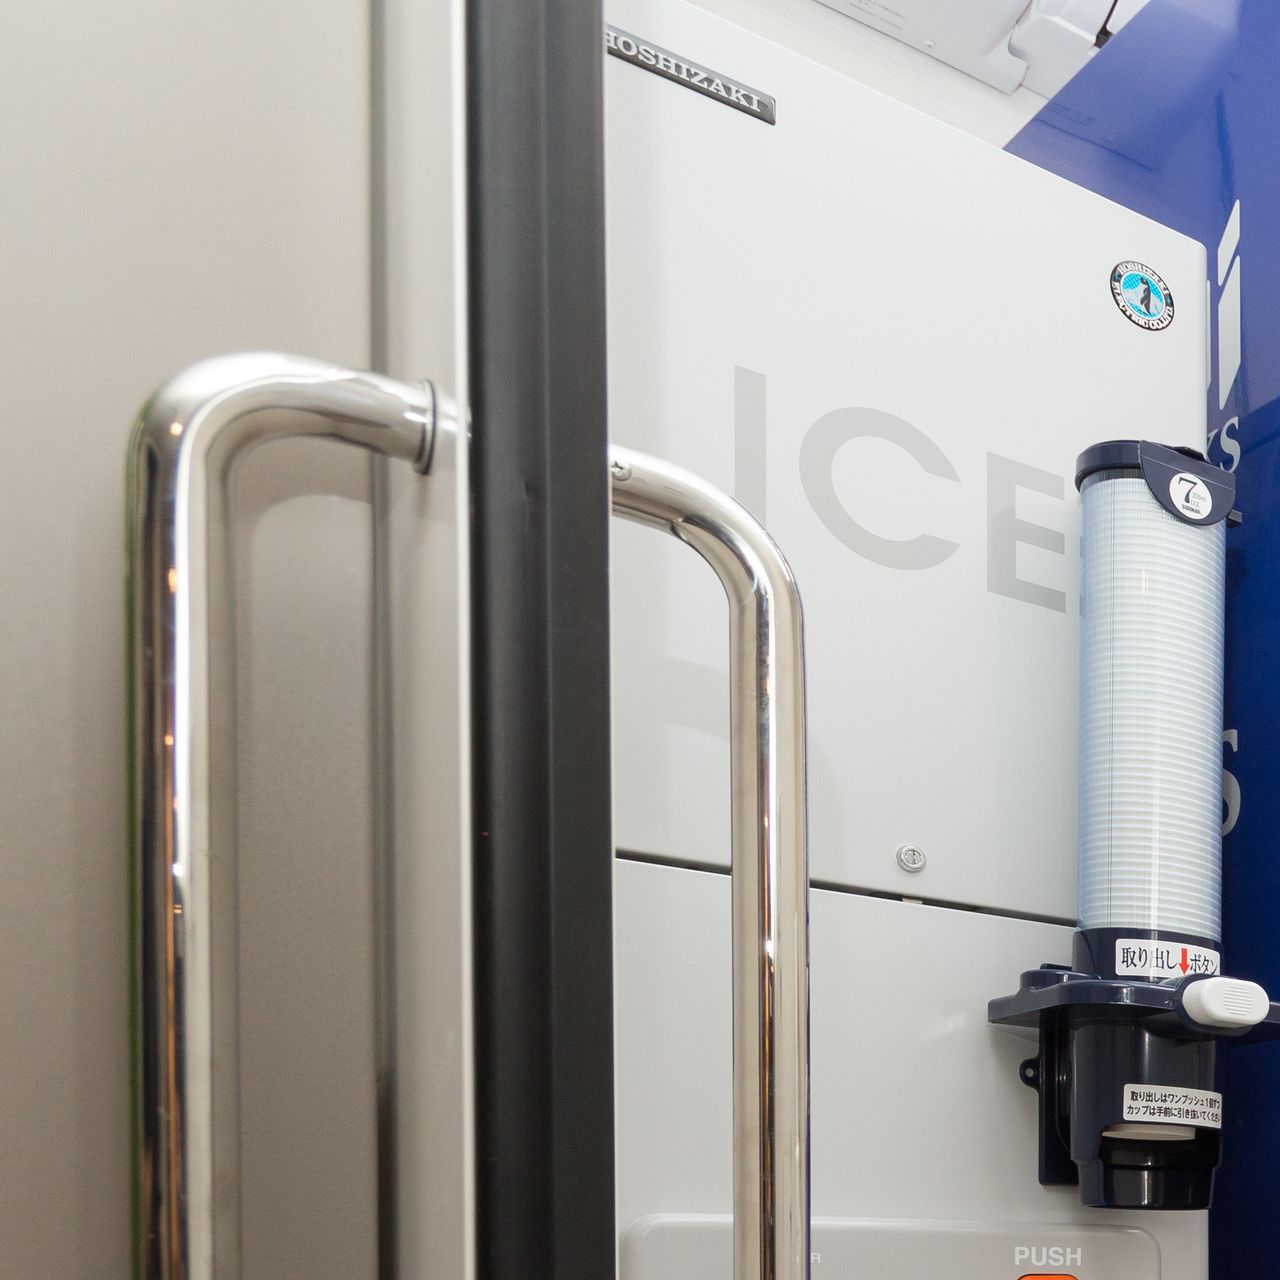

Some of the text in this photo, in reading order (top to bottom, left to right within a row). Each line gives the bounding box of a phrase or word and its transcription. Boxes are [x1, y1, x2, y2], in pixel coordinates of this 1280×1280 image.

[733, 365, 1065, 613] ICE
[1178, 476, 1198, 504] 7
[1121, 946, 1218, 975] 取り出し ボタン
[1013, 1246, 1083, 1267] PUSH
